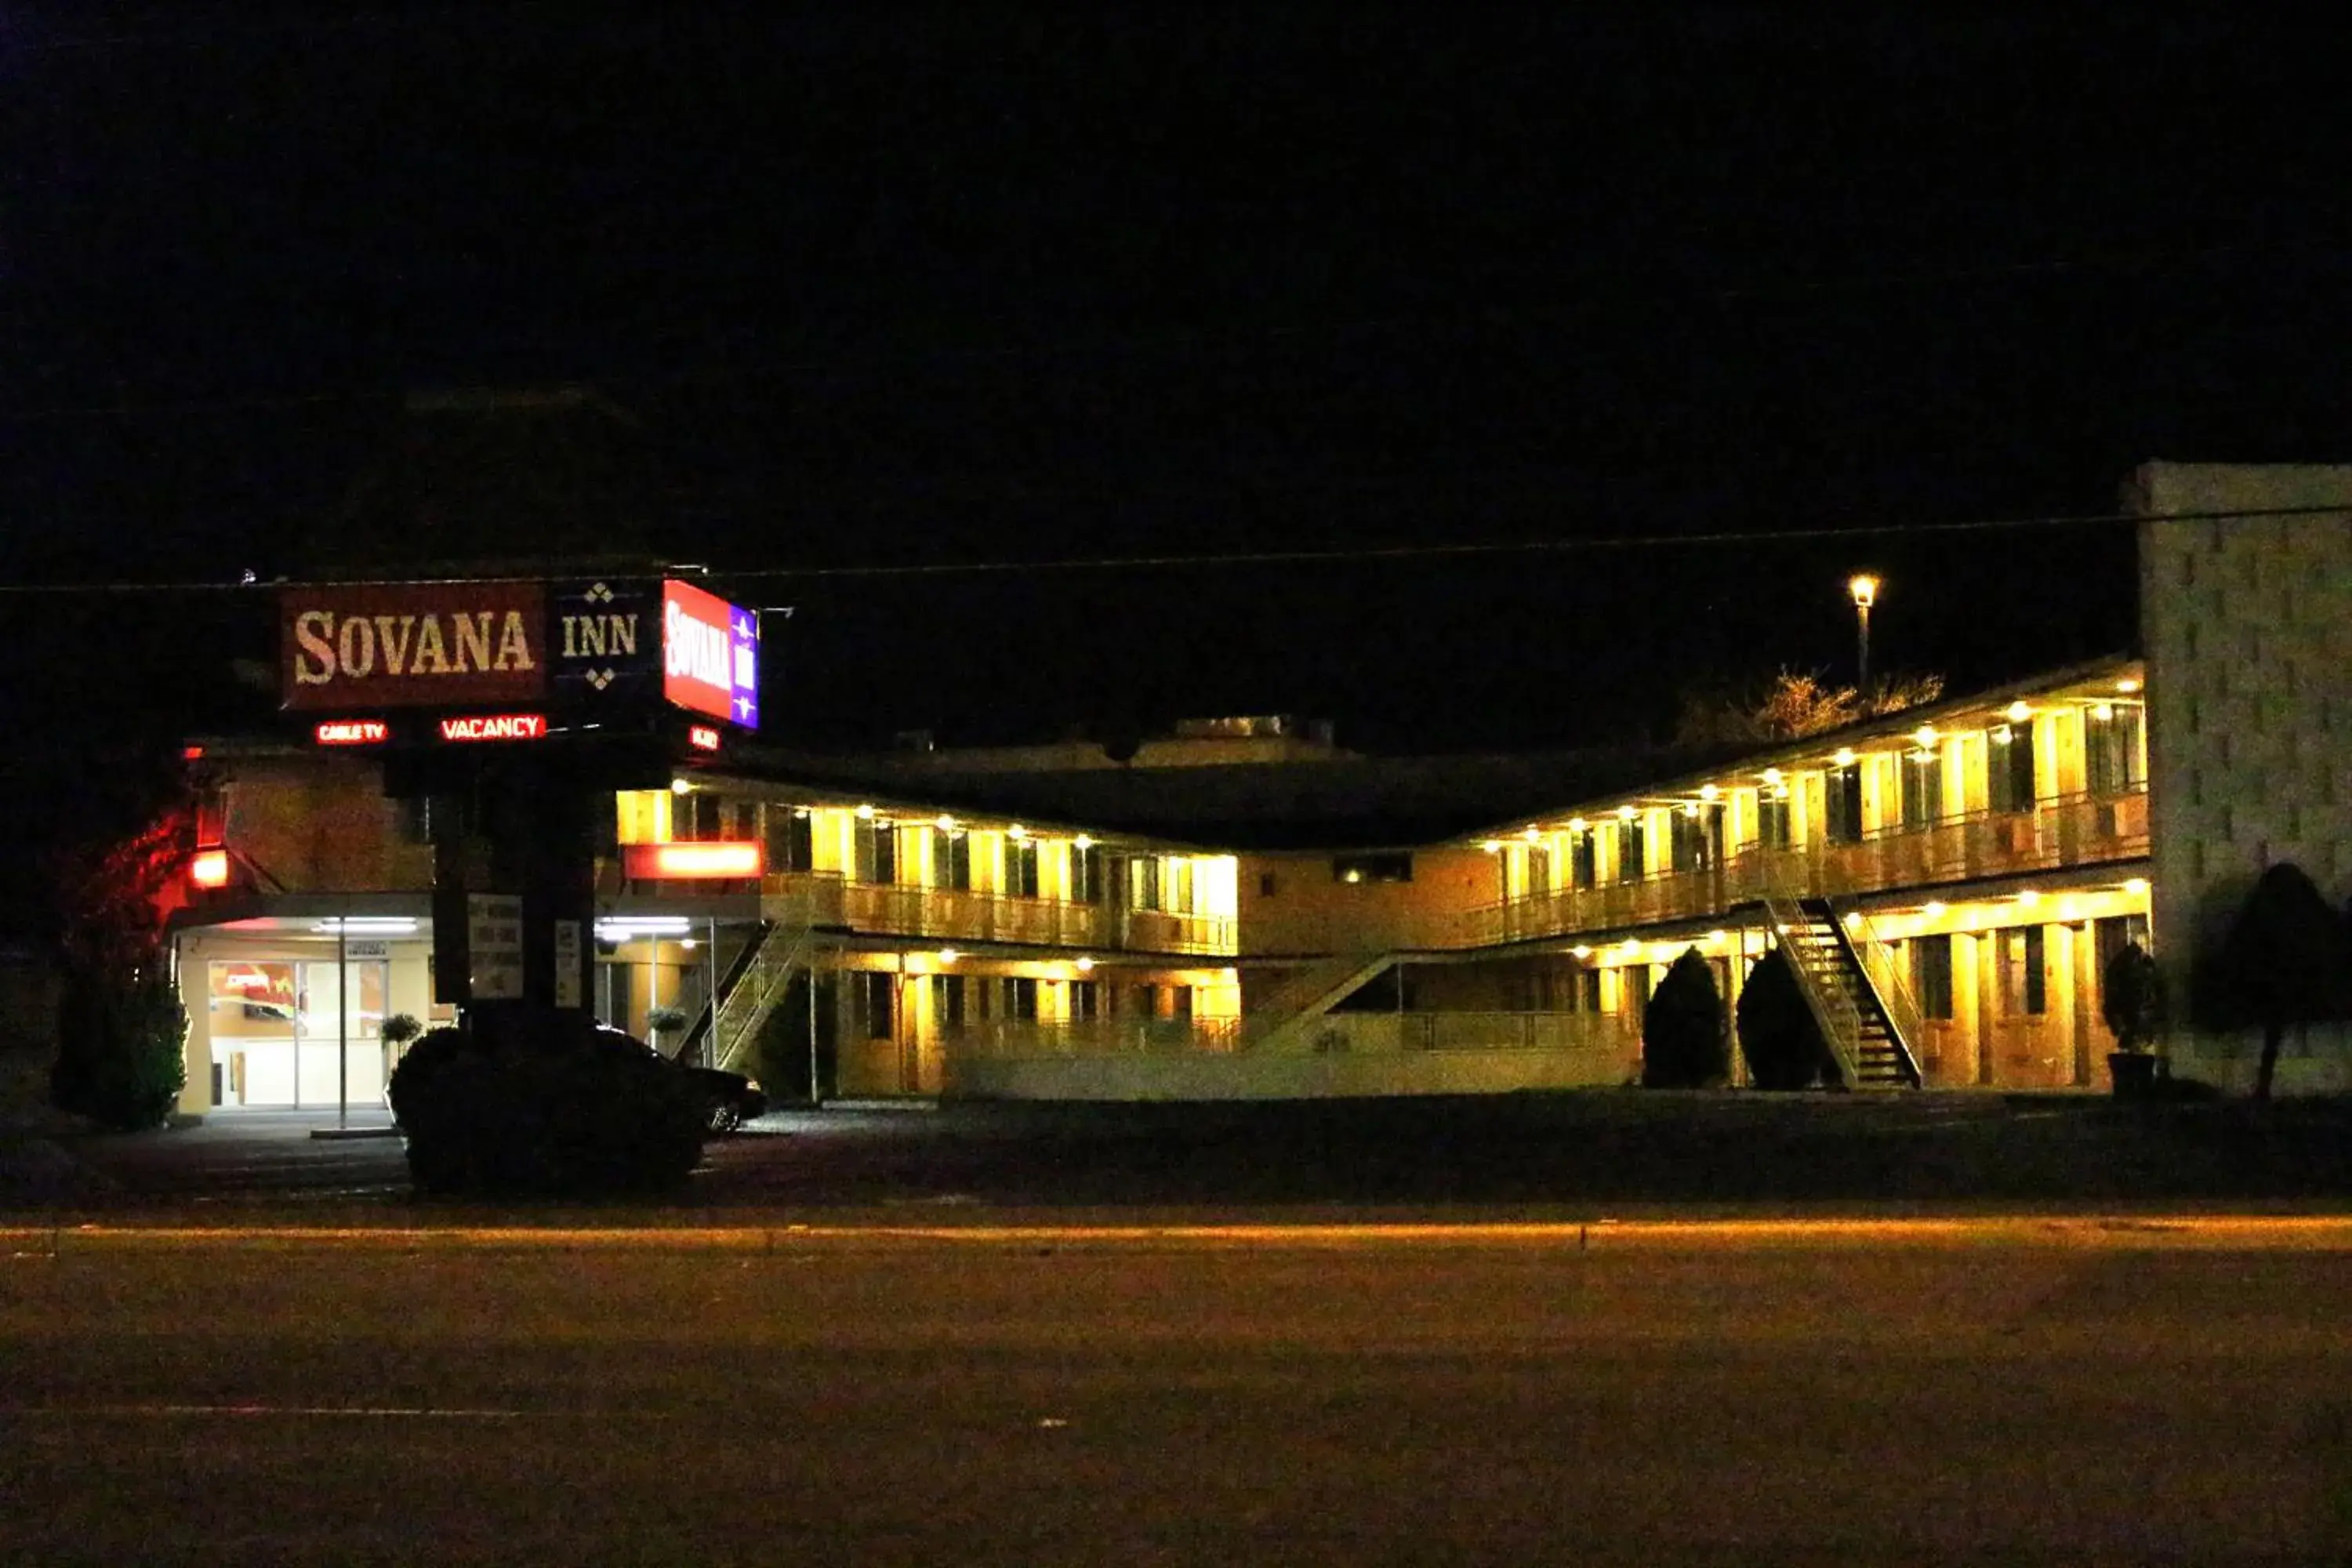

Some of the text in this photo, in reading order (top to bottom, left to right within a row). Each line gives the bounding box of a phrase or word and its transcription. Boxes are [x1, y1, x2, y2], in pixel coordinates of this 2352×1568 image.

[295, 611, 638, 684] SOVANA INN
[441, 717, 539, 739] VACANCY
